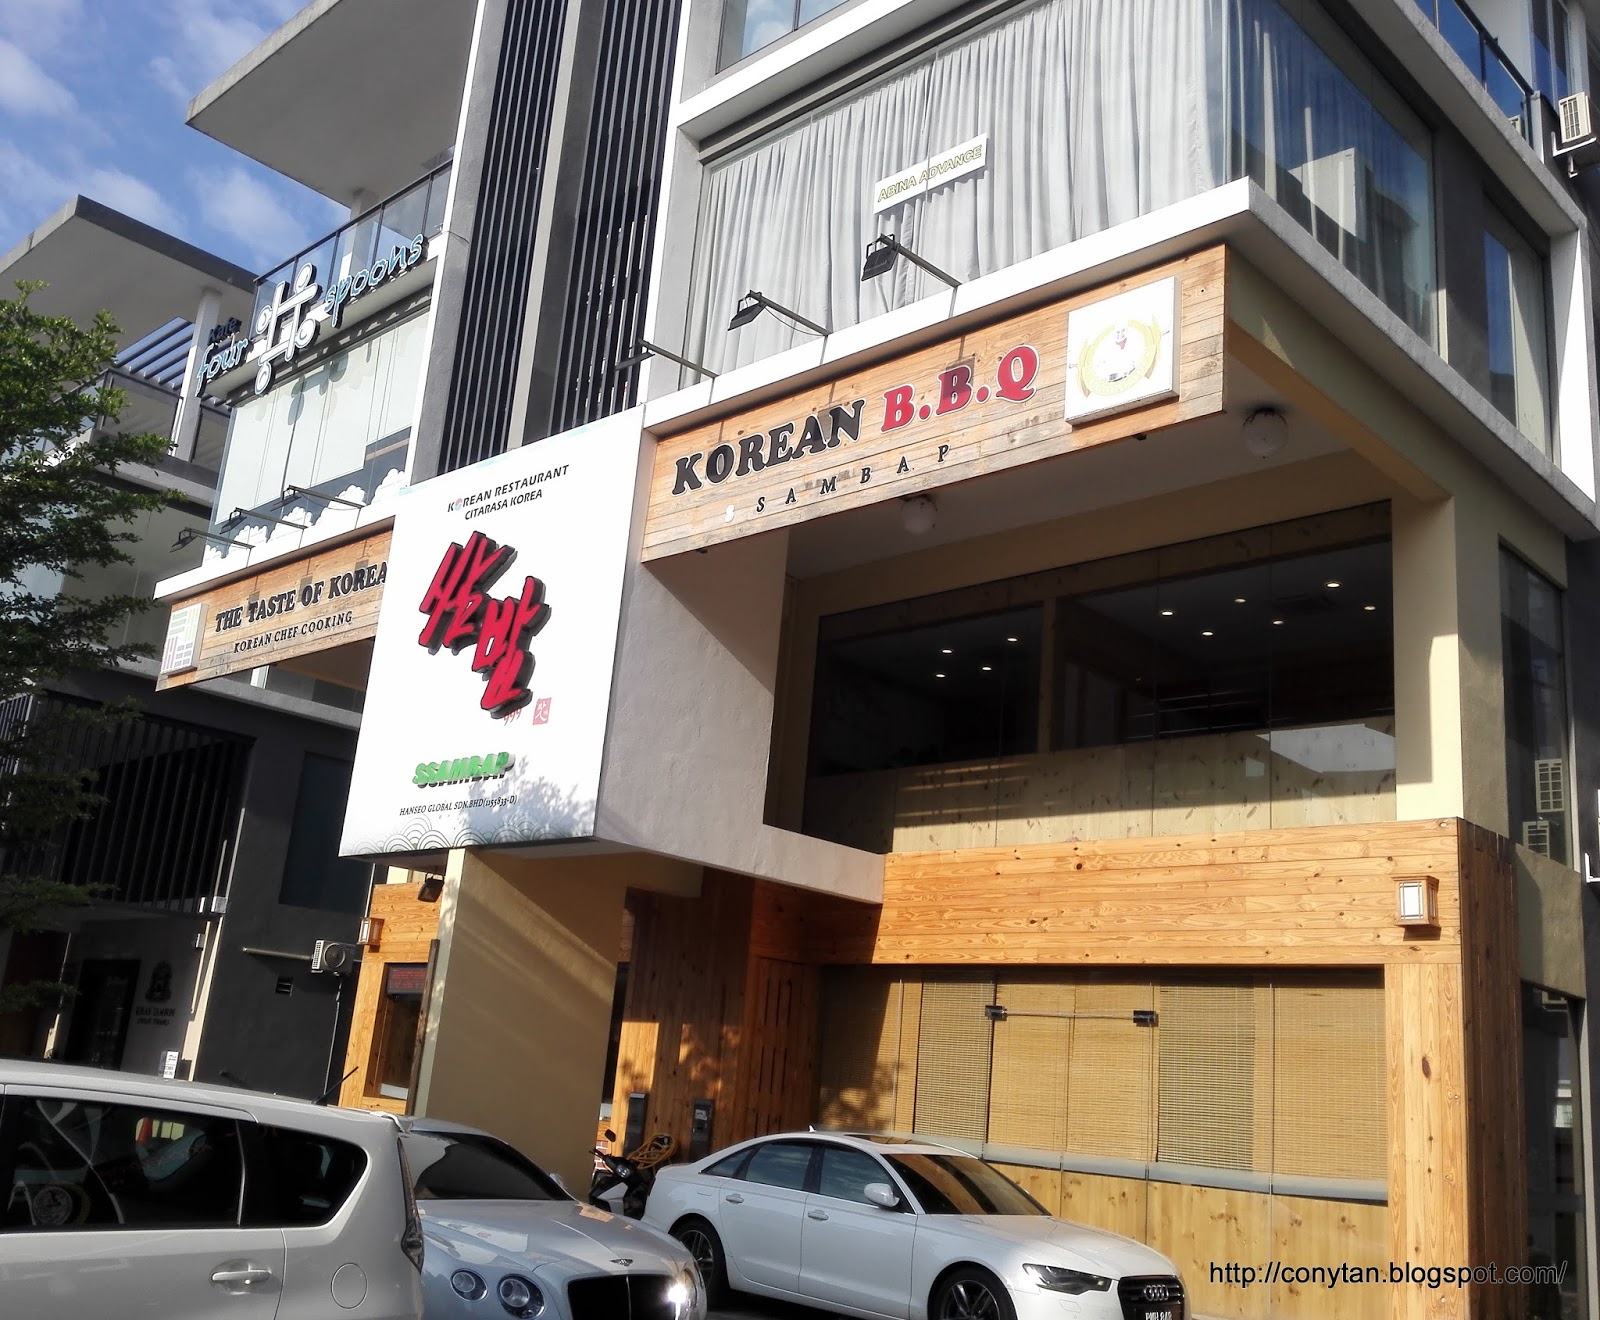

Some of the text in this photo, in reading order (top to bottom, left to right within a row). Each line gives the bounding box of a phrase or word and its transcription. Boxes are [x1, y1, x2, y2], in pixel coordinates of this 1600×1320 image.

[878, 144, 983, 203] ABINA ADVANCE
[323, 233, 428, 328] spoons
[195, 335, 254, 397] four
[671, 343, 1041, 496] KOREAN B.B.Q
[447, 464, 570, 513] KOREAN RESTAURANT
[464, 489, 543, 521] CITARASA KOREA
[214, 561, 388, 634] THE TASTE OF KOREA
[233, 610, 354, 655] KOREAN CHEF COOKING
[412, 751, 514, 786] SSAMBAP
[399, 806, 427, 817] HANSEO
[427, 802, 453, 814] GLOBAL
